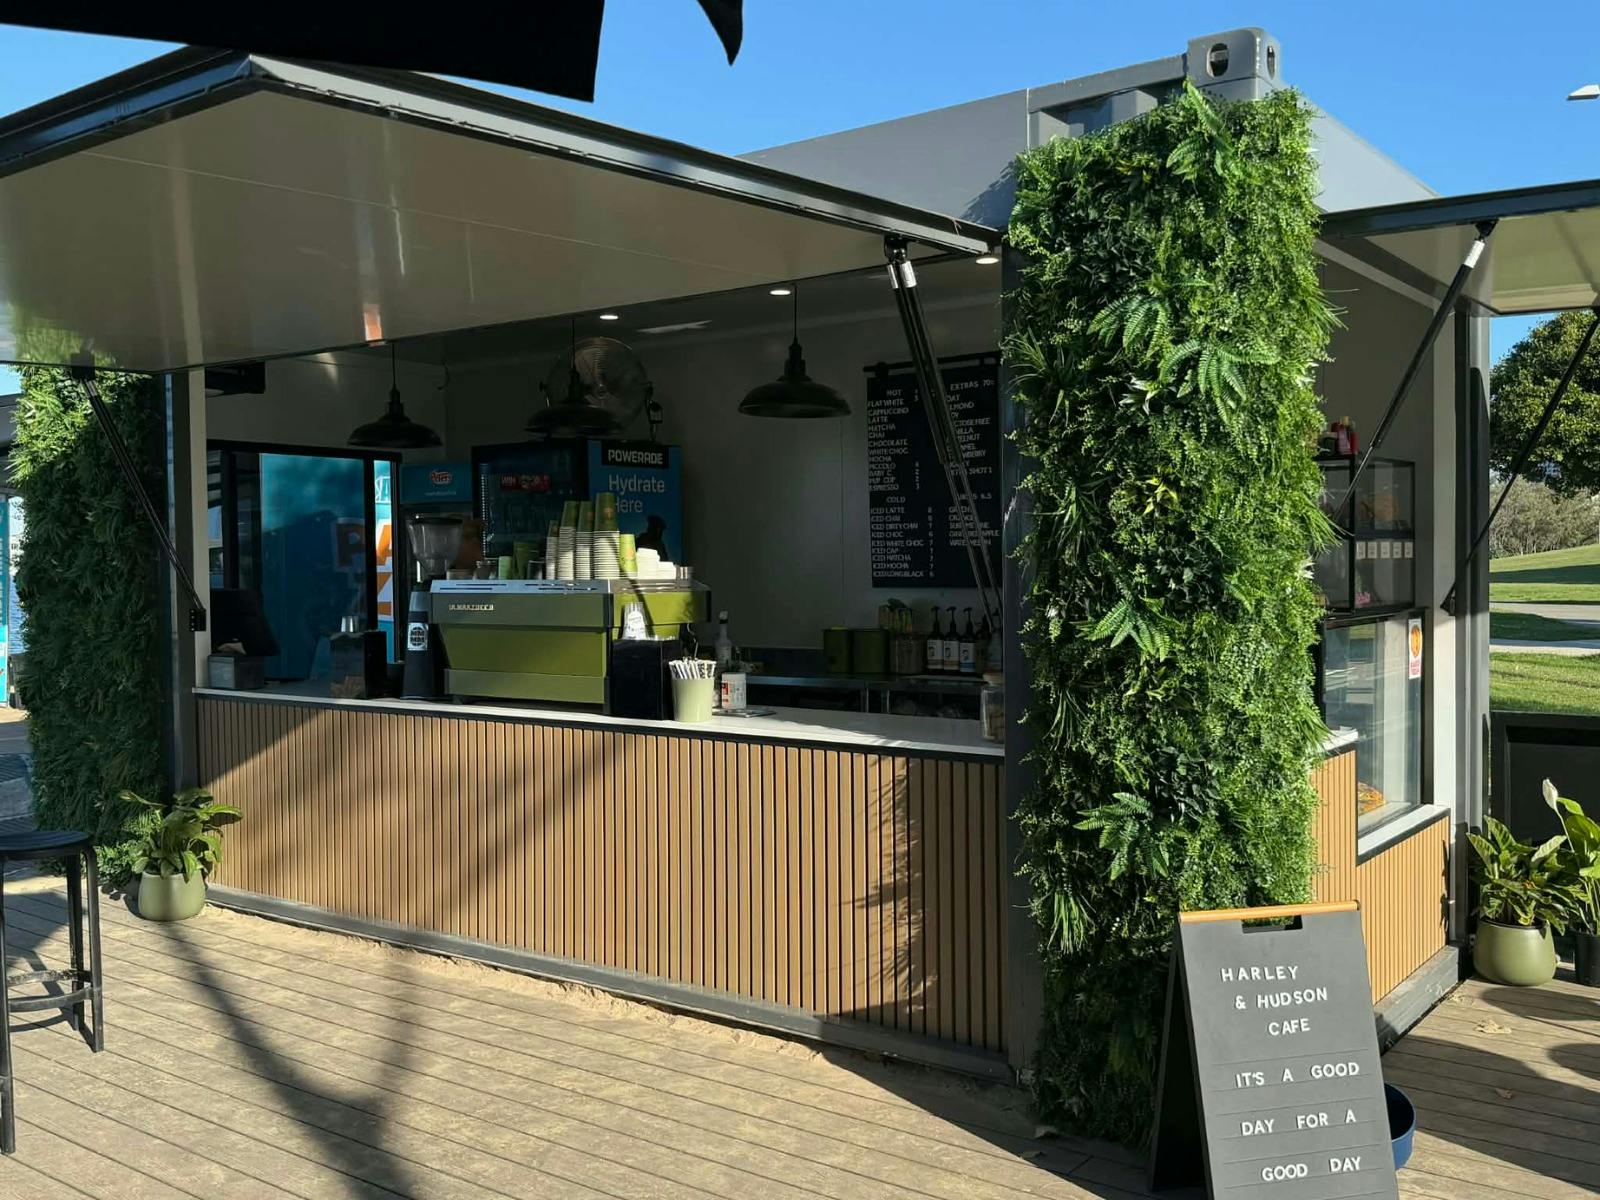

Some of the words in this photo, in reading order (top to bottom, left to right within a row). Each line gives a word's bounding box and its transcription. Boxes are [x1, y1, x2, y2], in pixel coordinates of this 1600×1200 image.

[868, 416, 888, 424] LATTE
[608, 449, 664, 464] POWERADE
[889, 447, 909, 455] CHOC
[609, 473, 665, 495] Hydrate
[1221, 965, 1299, 982] HARLEY
[1235, 995, 1246, 1010] &
[1257, 987, 1328, 1009] HUDSON
[1268, 1018, 1311, 1036] CAFE
[1236, 1071, 1265, 1088] IT'S
[1282, 1068, 1294, 1082] A
[1311, 1062, 1360, 1080] GOOD
[1241, 1119, 1275, 1137] DAY
[1296, 1113, 1329, 1130] FOR
[1345, 1109, 1357, 1124] A
[1262, 1163, 1308, 1182] GOOD
[1330, 1156, 1362, 1173] DAY
